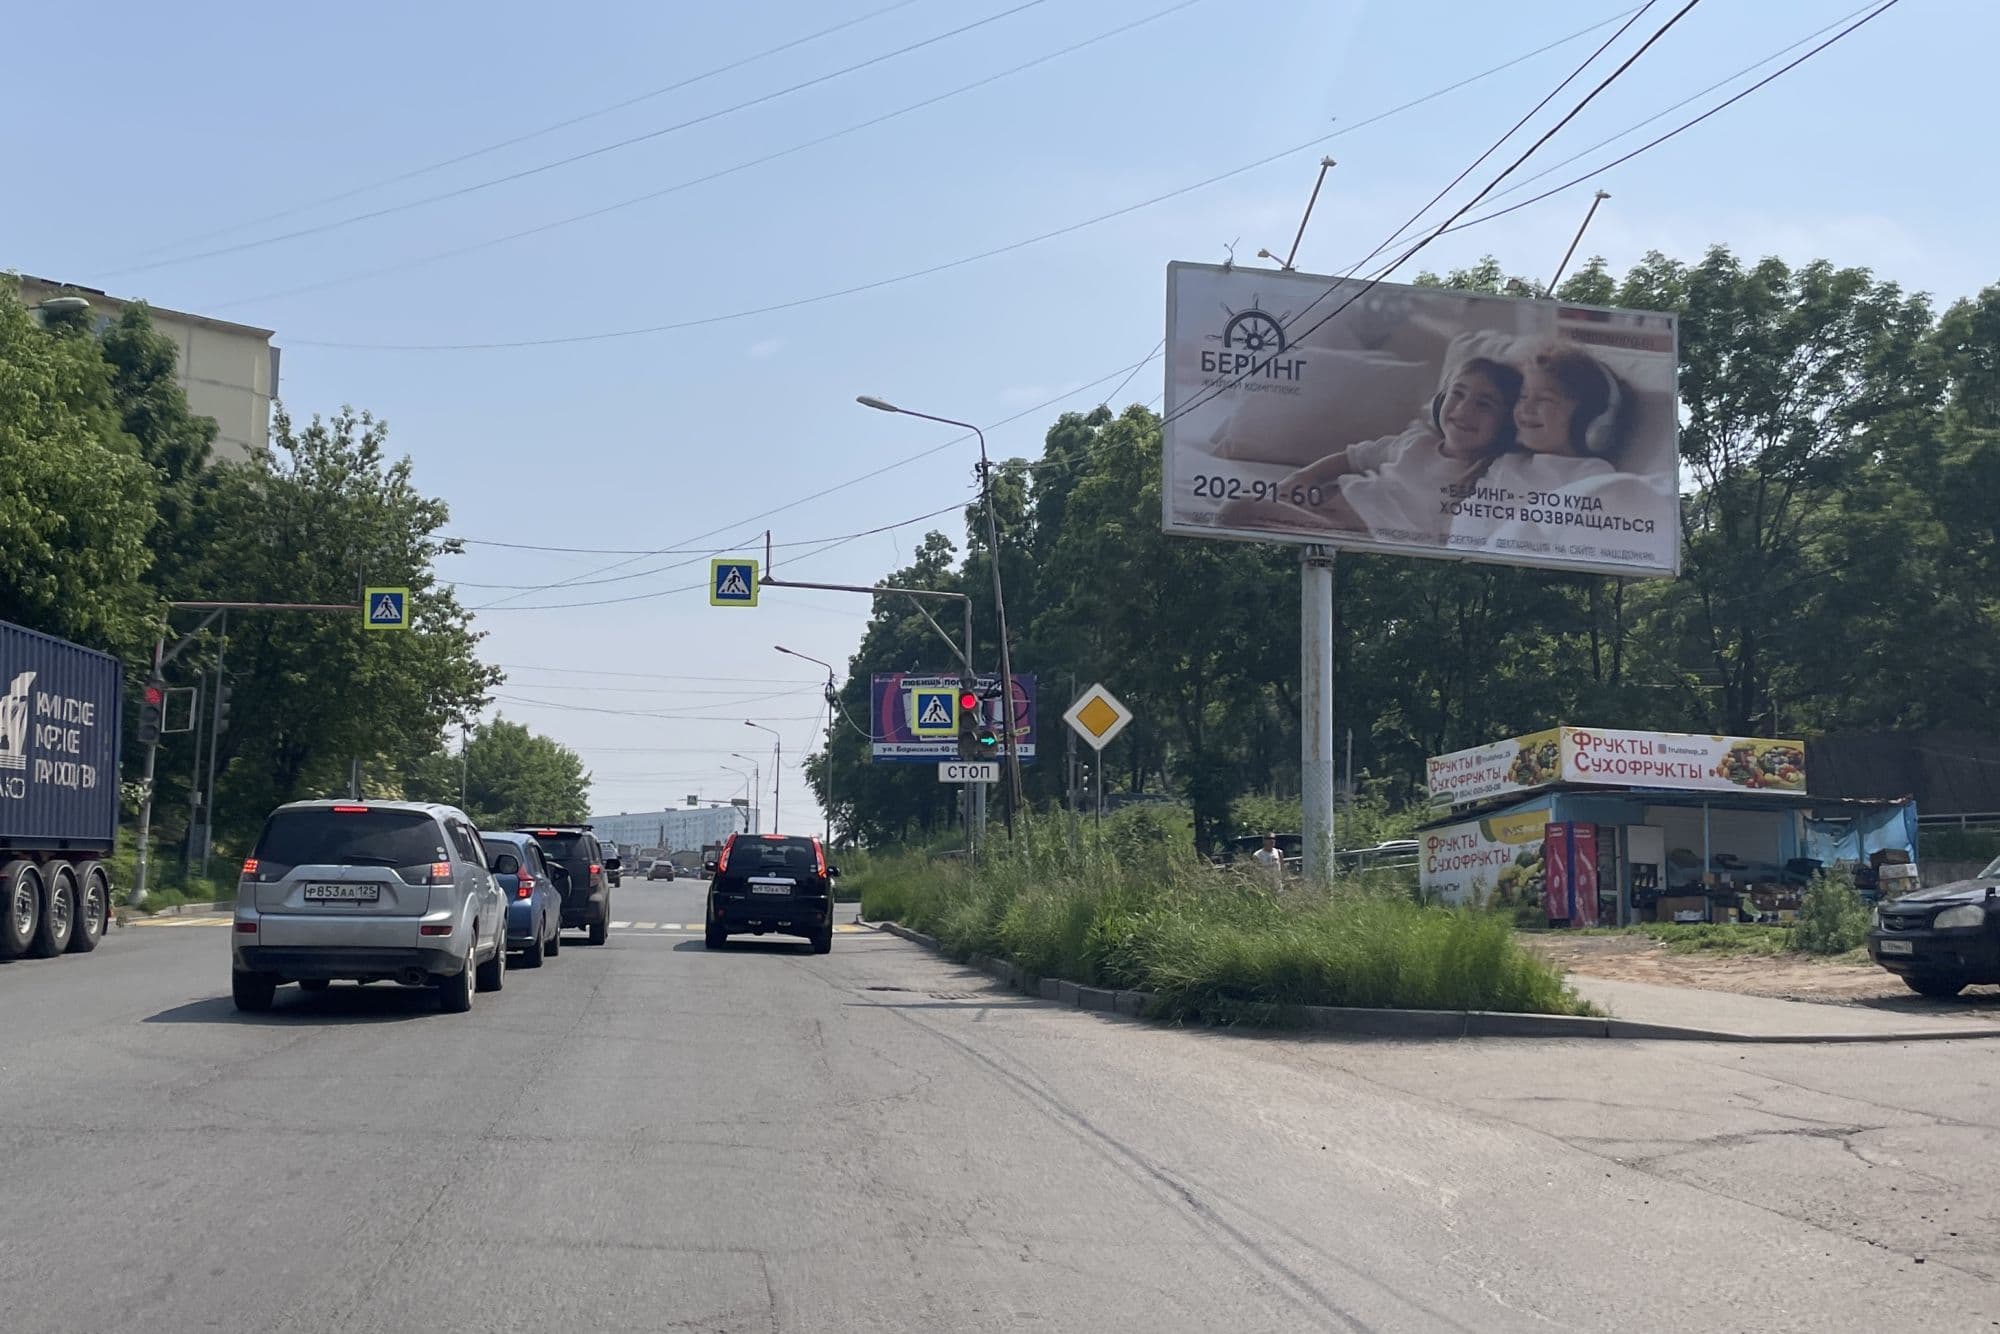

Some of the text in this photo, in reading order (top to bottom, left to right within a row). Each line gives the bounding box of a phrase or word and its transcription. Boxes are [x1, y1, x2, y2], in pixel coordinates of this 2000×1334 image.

[1201, 351, 1307, 381] БЕРИНГ
[1193, 475, 1323, 506] 202-91-60
[1527, 492, 1561, 507] ЭТО
[1564, 495, 1603, 512] КУДА
[1440, 502, 1655, 534] ХОЧЕТСЯ ВОЗВРАЩАТЬСЯ
[1572, 731, 1653, 756] ФРУКТЫ
[948, 765, 990, 779] СТОП
[1430, 756, 1473, 777] ФРУКТЫ
[1574, 752, 1702, 779] СУХОФРУКТЫ
[1430, 767, 1501, 793] СУХОФРУКТЫ
[1427, 833, 1478, 853] ФРУКТЫ
[1427, 848, 1511, 874] СУХОФРУКТЫ
